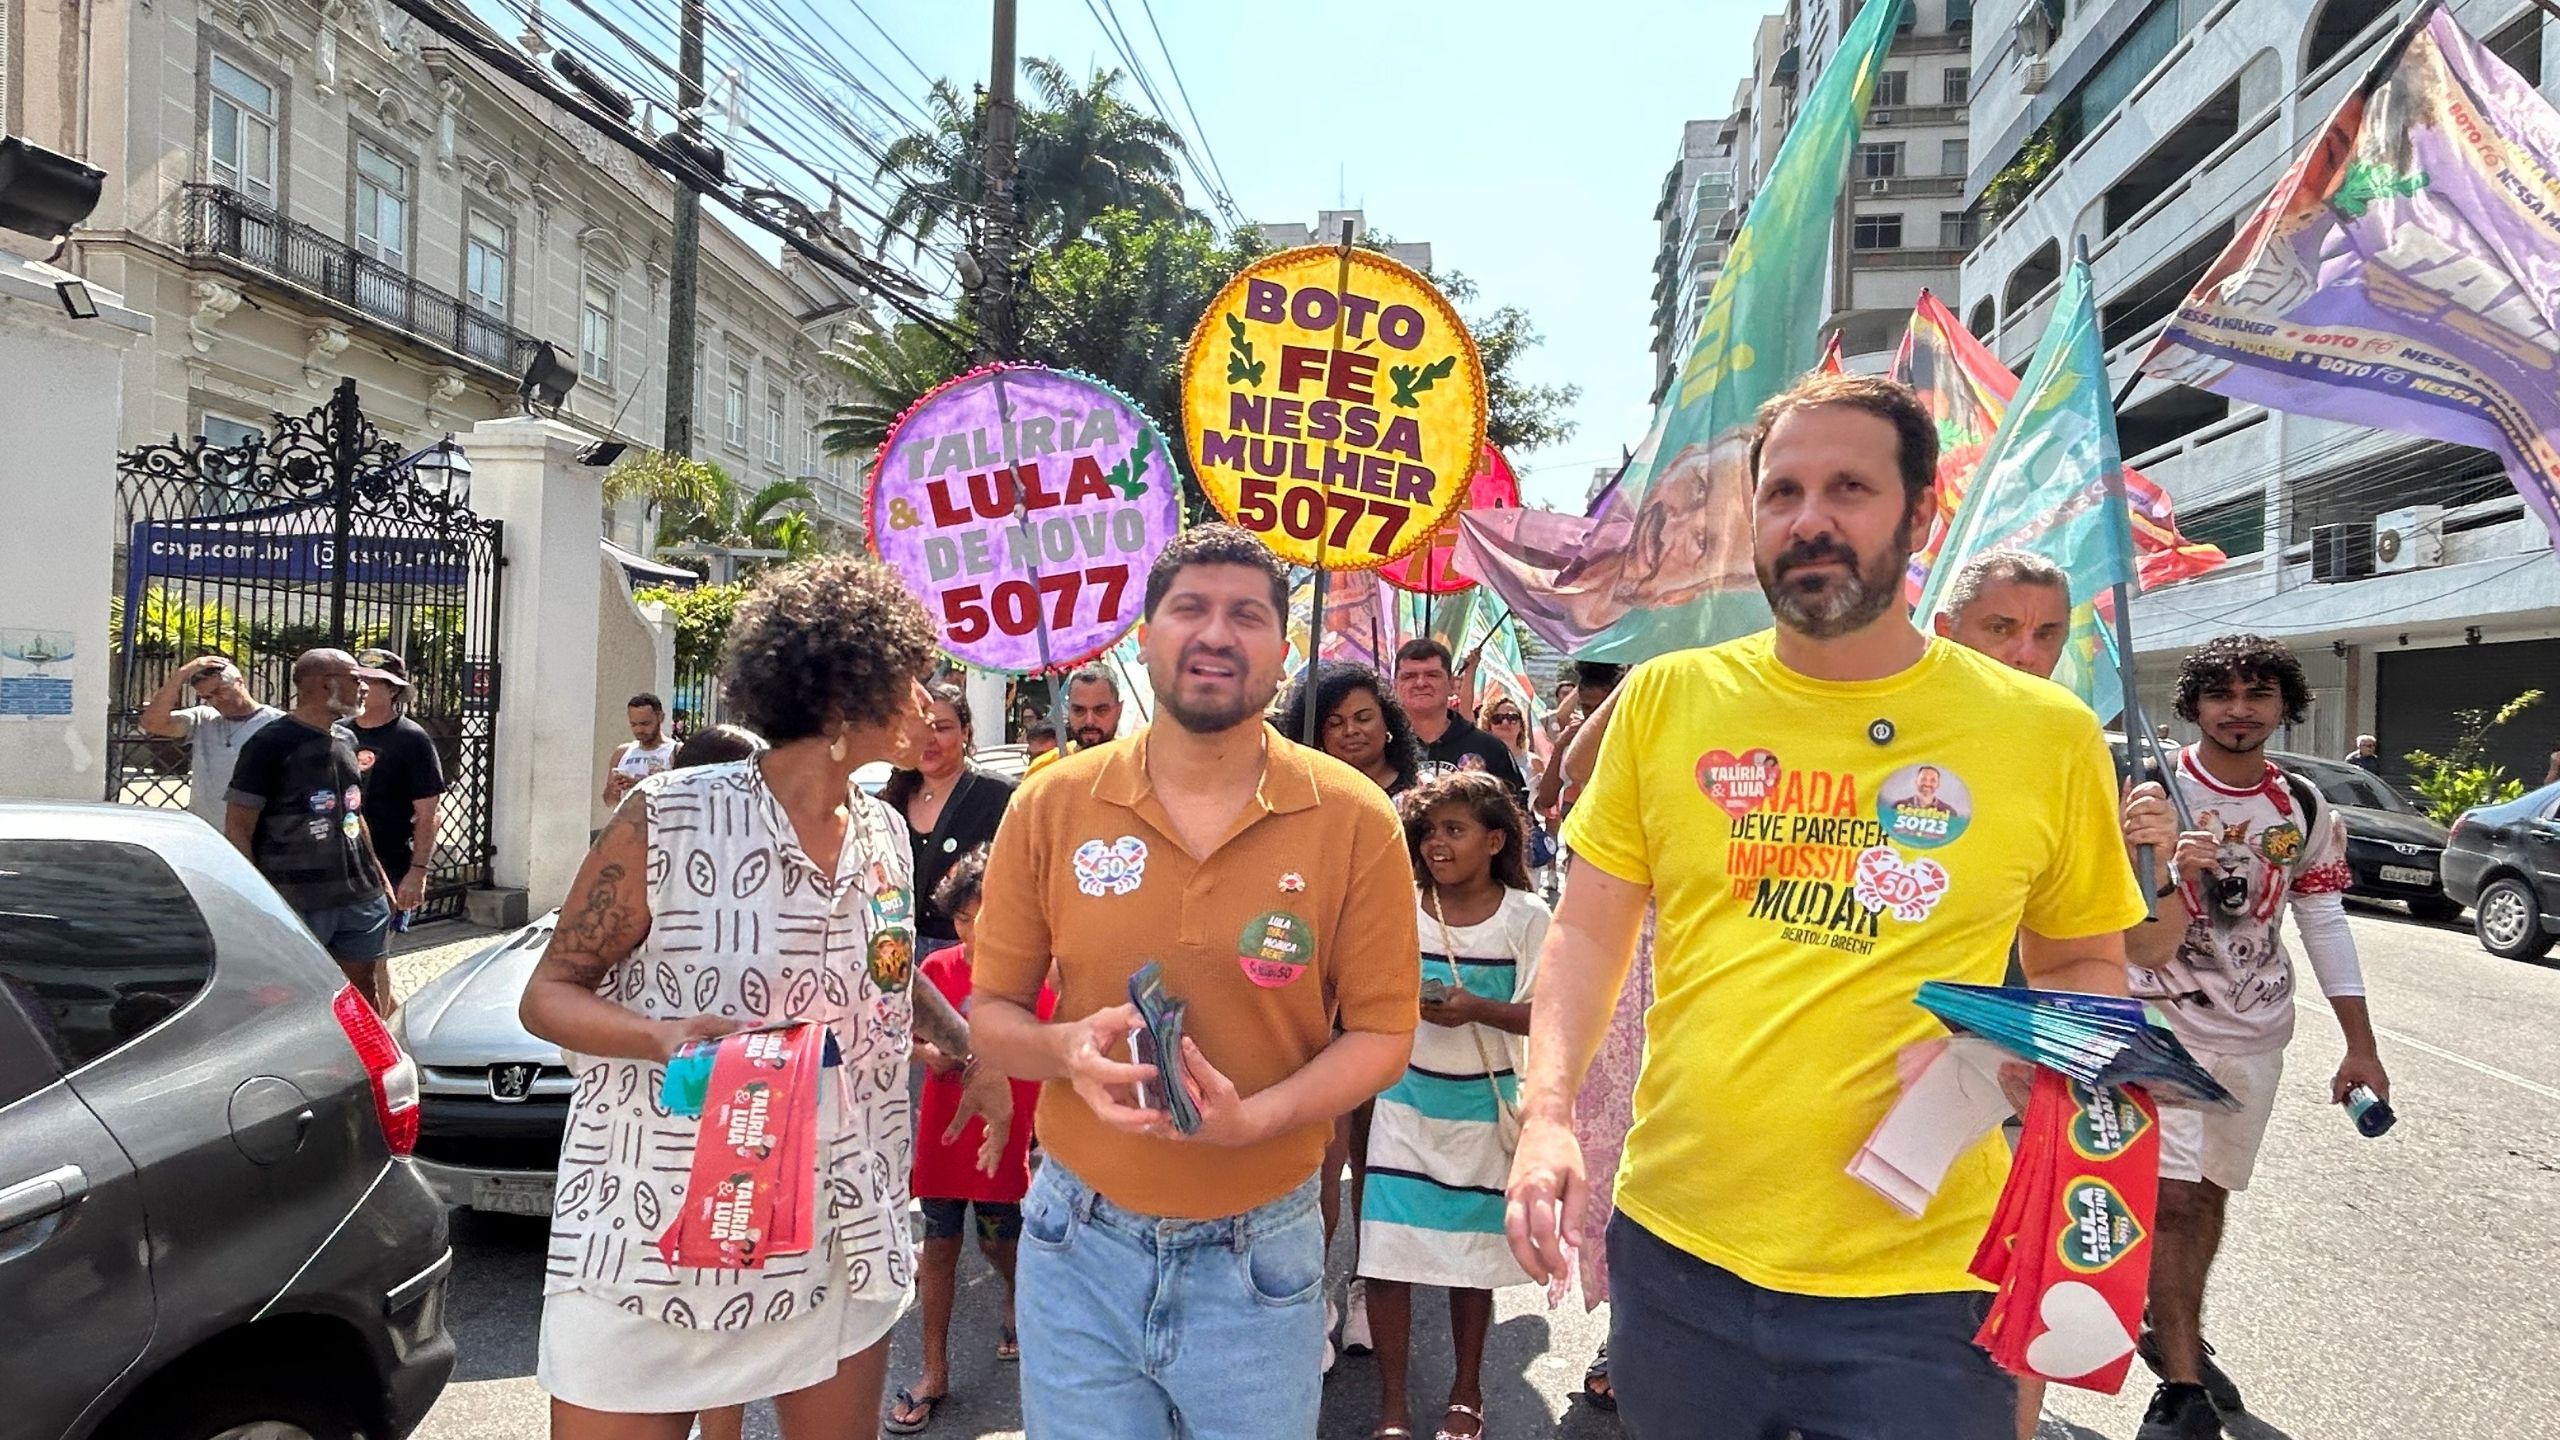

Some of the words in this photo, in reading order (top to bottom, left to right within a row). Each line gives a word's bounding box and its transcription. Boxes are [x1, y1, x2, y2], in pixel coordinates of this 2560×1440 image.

[2448, 102, 2482, 144] BOTO
[2496, 168, 2545, 215] NESSA
[1245, 278, 1425, 350] BOTO
[1279, 339, 1379, 406] FÉ
[2221, 318, 2278, 336] MULHER
[2302, 332, 2358, 348] BOTO
[2399, 348, 2471, 378] NESSA
[2317, 357, 2372, 376] BOTO
[2409, 377, 2482, 407] NESSA
[1229, 392, 1423, 462] NESSA
[889, 498, 923, 531] &
[926, 455, 1116, 528] LULA
[1201, 429, 1436, 506] MULHER
[924, 529, 993, 582] DE
[1006, 508, 1145, 570] NOVO
[1237, 477, 1410, 556] 5077
[941, 564, 1129, 643] 5077
[1711, 763, 1766, 780] TALÍRIA
[1711, 784, 1726, 797] &
[1730, 782, 1765, 797] LULA
[1731, 814, 1786, 842] DEVE
[1893, 816, 1948, 834] 50123
[1096, 857, 1123, 879] 50
[1733, 878, 1757, 901] DE
[1879, 873, 1915, 899] 50
[1830, 934, 1875, 955] BRECHT
[727, 1109, 749, 1145] LULA
[745, 1088, 770, 1147] TALÍRIA
[710, 1201, 732, 1239] LULA
[729, 1180, 754, 1241] TALÍRIA
[2078, 1187, 2100, 1263] LULA
[2095, 1188, 2111, 1252] SERAFINI
